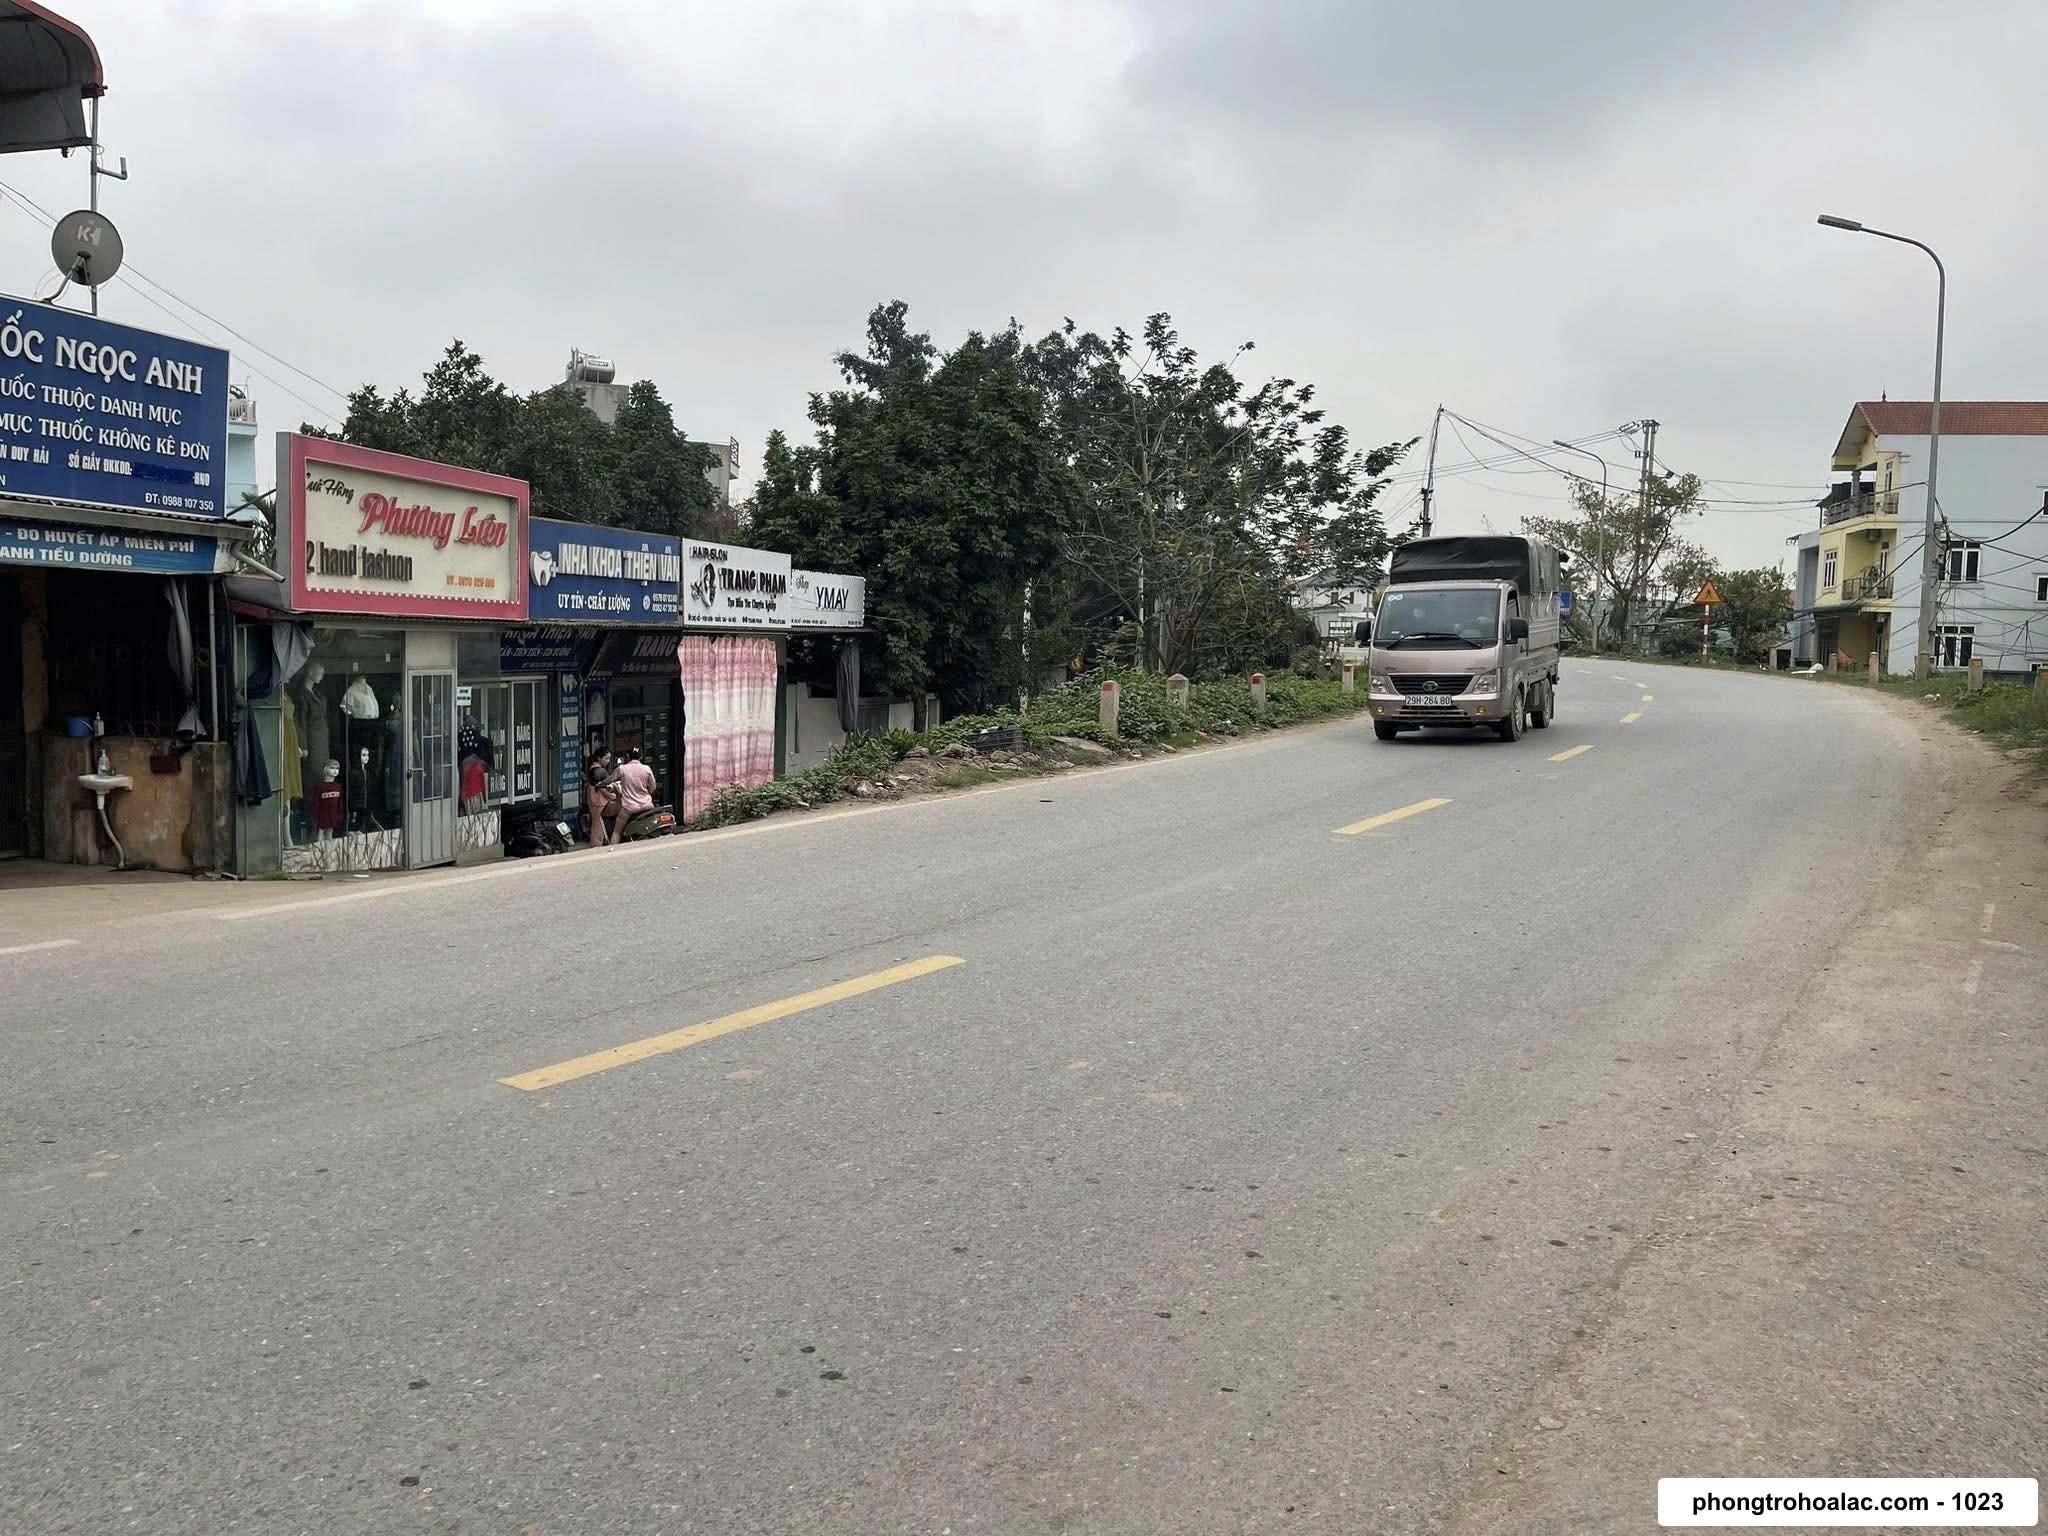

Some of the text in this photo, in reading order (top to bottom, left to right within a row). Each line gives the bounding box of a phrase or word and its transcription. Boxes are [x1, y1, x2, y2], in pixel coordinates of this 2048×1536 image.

[0, 309, 203, 395] ỐC NGỌC ANH
[41, 385, 96, 413] THUỘC
[101, 395, 144, 419] DANH
[148, 404, 182, 427] MỤC
[38, 417, 94, 442] THUỐC
[98, 427, 151, 452] KHÔNG
[156, 434, 176, 456] KÊ
[180, 441, 210, 461] ĐƠN
[11, 445, 29, 462] DUY
[33, 445, 50, 464] HẢI
[145, 492, 214, 511] ĐT: 0988 107 350
[323, 478, 354, 505] Hàng
[358, 492, 509, 549] Phương Liên
[17, 528, 40, 541] ĐO
[45, 530, 95, 546] HUYẾT
[99, 530, 120, 547] ÁP
[168, 539, 194, 553] PHÍ
[79, 550, 133, 567] ĐƯỜNG
[317, 541, 357, 577] hand
[358, 546, 413, 581] fashion
[559, 543, 680, 586] NHA KHOA THIỆN VÂN
[719, 567, 757, 593] TRANG
[558, 593, 568, 609] UY
[571, 590, 585, 609] TÍN
[816, 586, 849, 610] YMAY
[632, 635, 678, 657] TRANG
